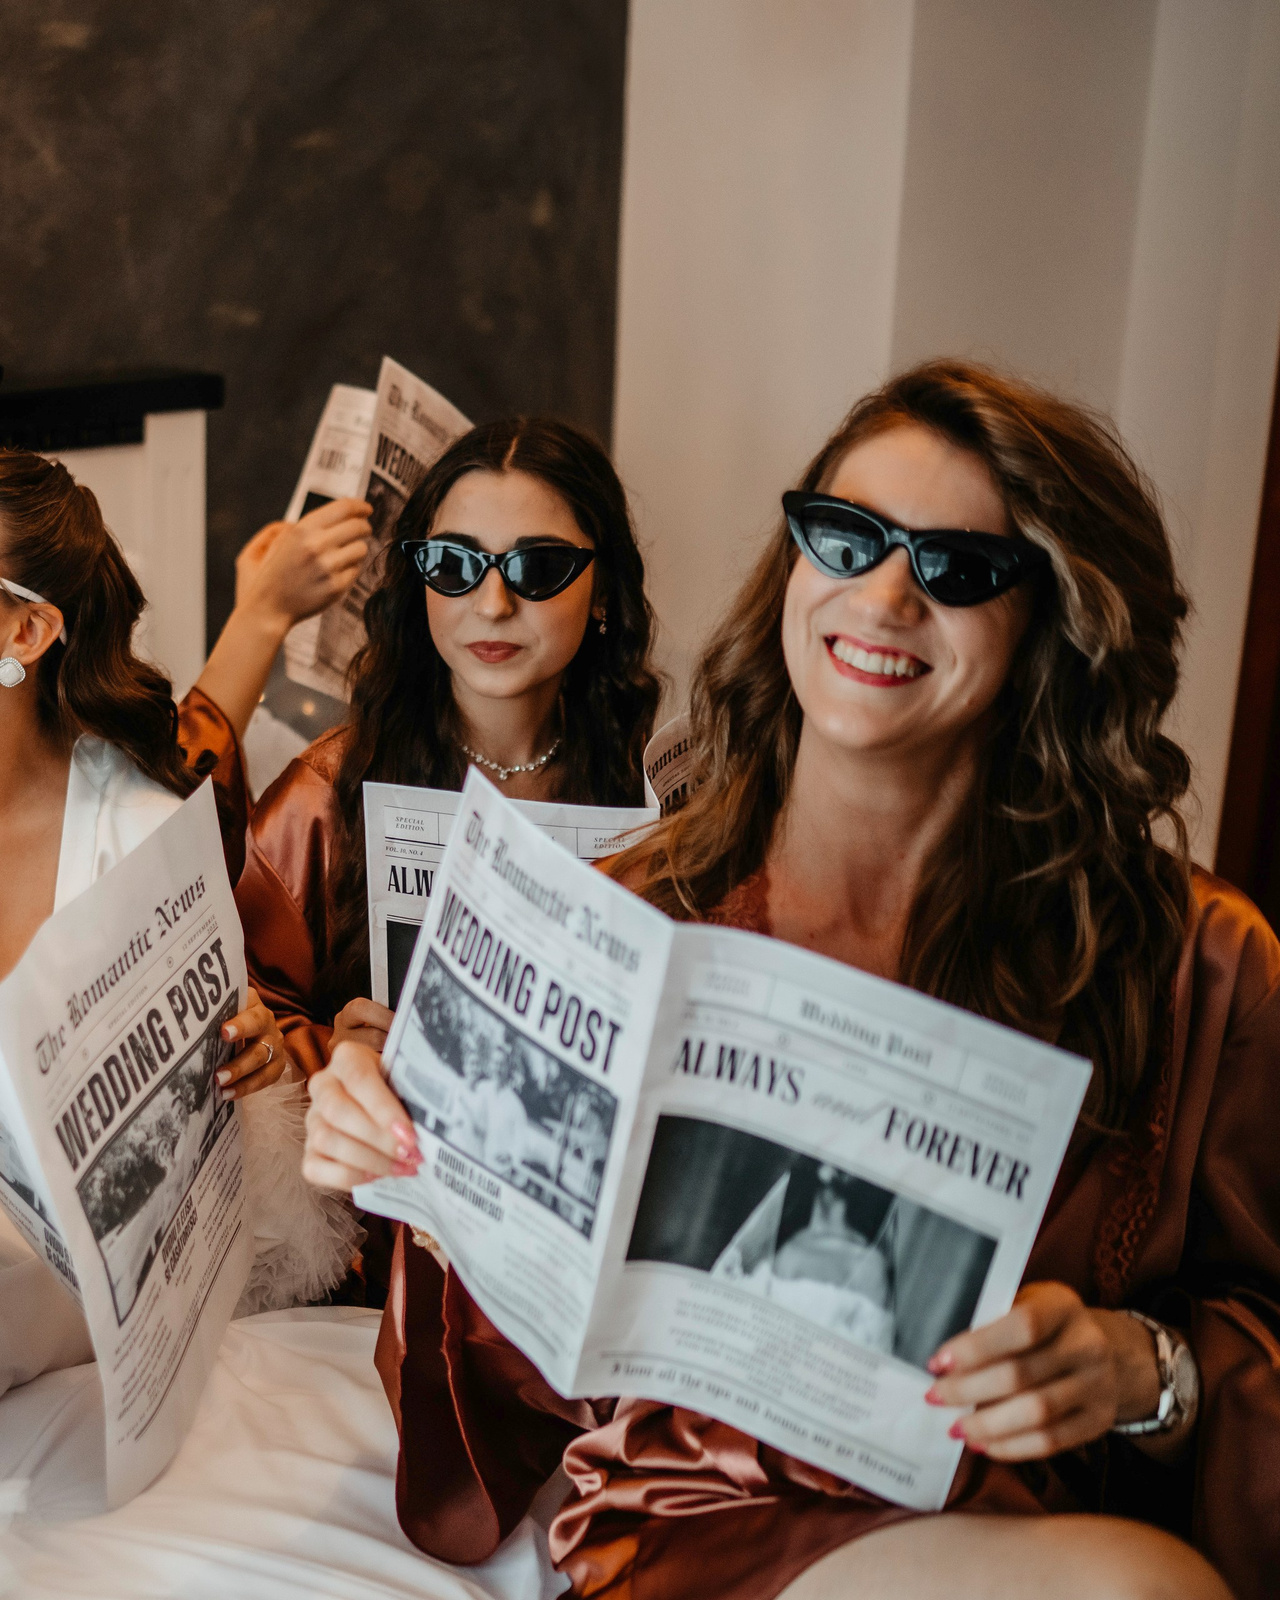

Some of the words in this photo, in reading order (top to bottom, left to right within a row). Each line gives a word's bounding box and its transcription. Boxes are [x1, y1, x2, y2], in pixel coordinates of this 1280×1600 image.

[395, 816, 425, 825] SPECIAL
[396, 823, 425, 831] EDITION
[188, 914, 216, 945] SEPTEMBRIE
[388, 865, 434, 897] ALW
[490, 837, 574, 929] Romantic
[576, 904, 641, 974] News
[35, 1024, 66, 1076] The
[66, 928, 153, 1032] Romantic
[154, 875, 206, 940] News
[436, 886, 537, 1016] WEDDING
[538, 980, 623, 1074] POST
[55, 1008, 176, 1174] WEDDING
[166, 936, 230, 1042] POST
[798, 998, 882, 1049] Wedding
[886, 1029, 934, 1070] Post
[671, 1037, 806, 1106] ALWAYS
[883, 1106, 1033, 1200] FOREVER
